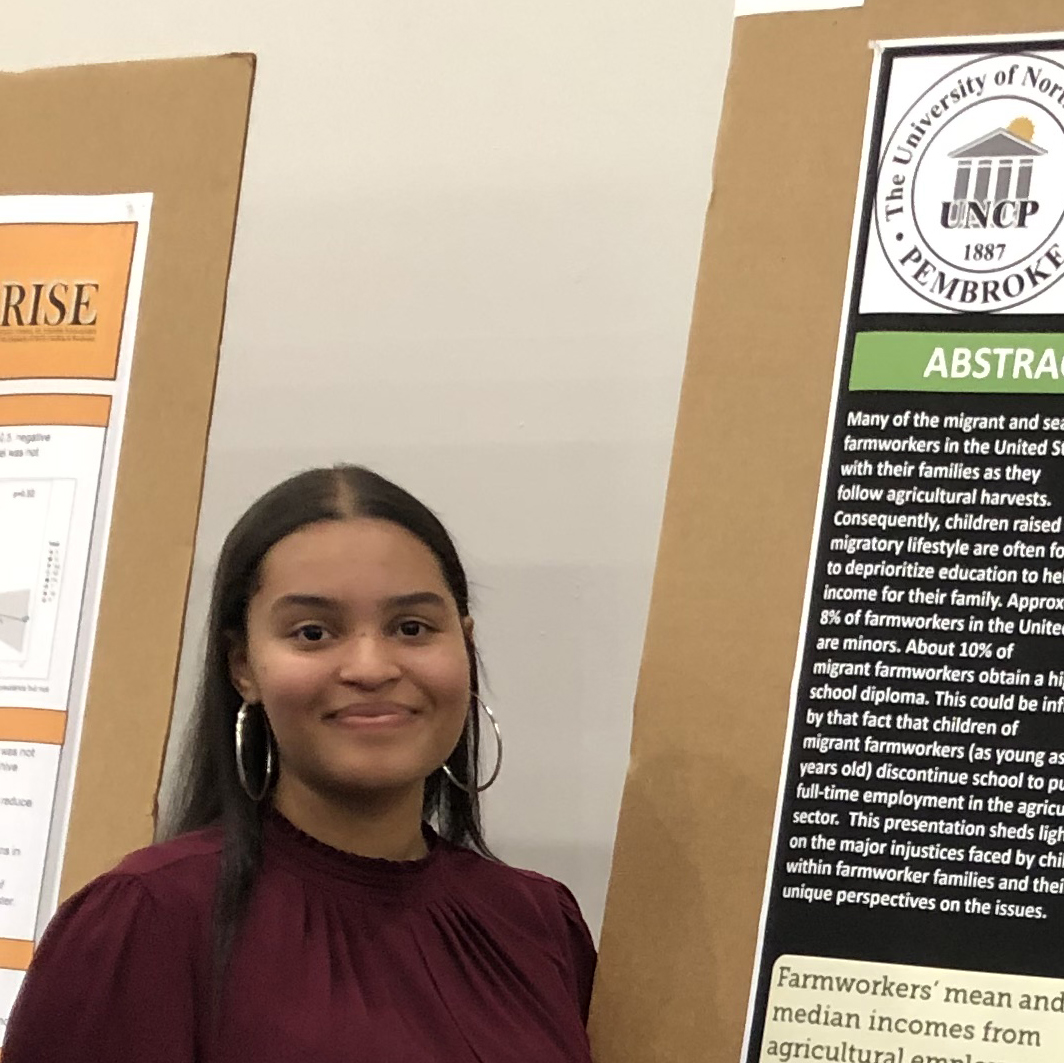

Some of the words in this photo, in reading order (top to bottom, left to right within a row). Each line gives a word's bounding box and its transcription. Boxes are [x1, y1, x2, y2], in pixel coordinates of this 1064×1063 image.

[994, 64, 1019, 86] of
[893, 73, 987, 165] University
[885, 173, 906, 222] The
[940, 201, 1040, 229] UNCP
[964, 244, 1006, 261] 1887
[0, 283, 99, 326] RISE
[847, 411, 890, 430] Many
[892, 410, 911, 427] of
[912, 411, 940, 428] the
[943, 412, 1006, 432] migrant
[1008, 413, 1040, 430] and
[833, 510, 940, 532] Consequently,
[944, 513, 1009, 531] children
[1012, 515, 1062, 533] raised
[823, 583, 878, 601] income
[881, 585, 905, 602] for
[908, 587, 947, 605] their
[950, 588, 1003, 611] family.
[809, 683, 857, 700] school
[860, 685, 930, 706] diploma.
[934, 690, 966, 708] This
[969, 693, 1015, 710] could
[1017, 694, 1038, 712] be
[796, 782, 859, 802] full-time
[862, 789, 965, 810] employment
[968, 794, 983, 811] in
[987, 796, 1014, 813] the
[782, 886, 833, 903] unique
[835, 890, 936, 910] perspectives
[939, 899, 960, 912] on
[964, 897, 991, 915] the
[994, 899, 1047, 919] issues.
[943, 987, 1012, 1008] mean
[772, 1003, 860, 1029] median
[868, 1009, 975, 1040] incomes
[981, 1020, 1041, 1047] from
